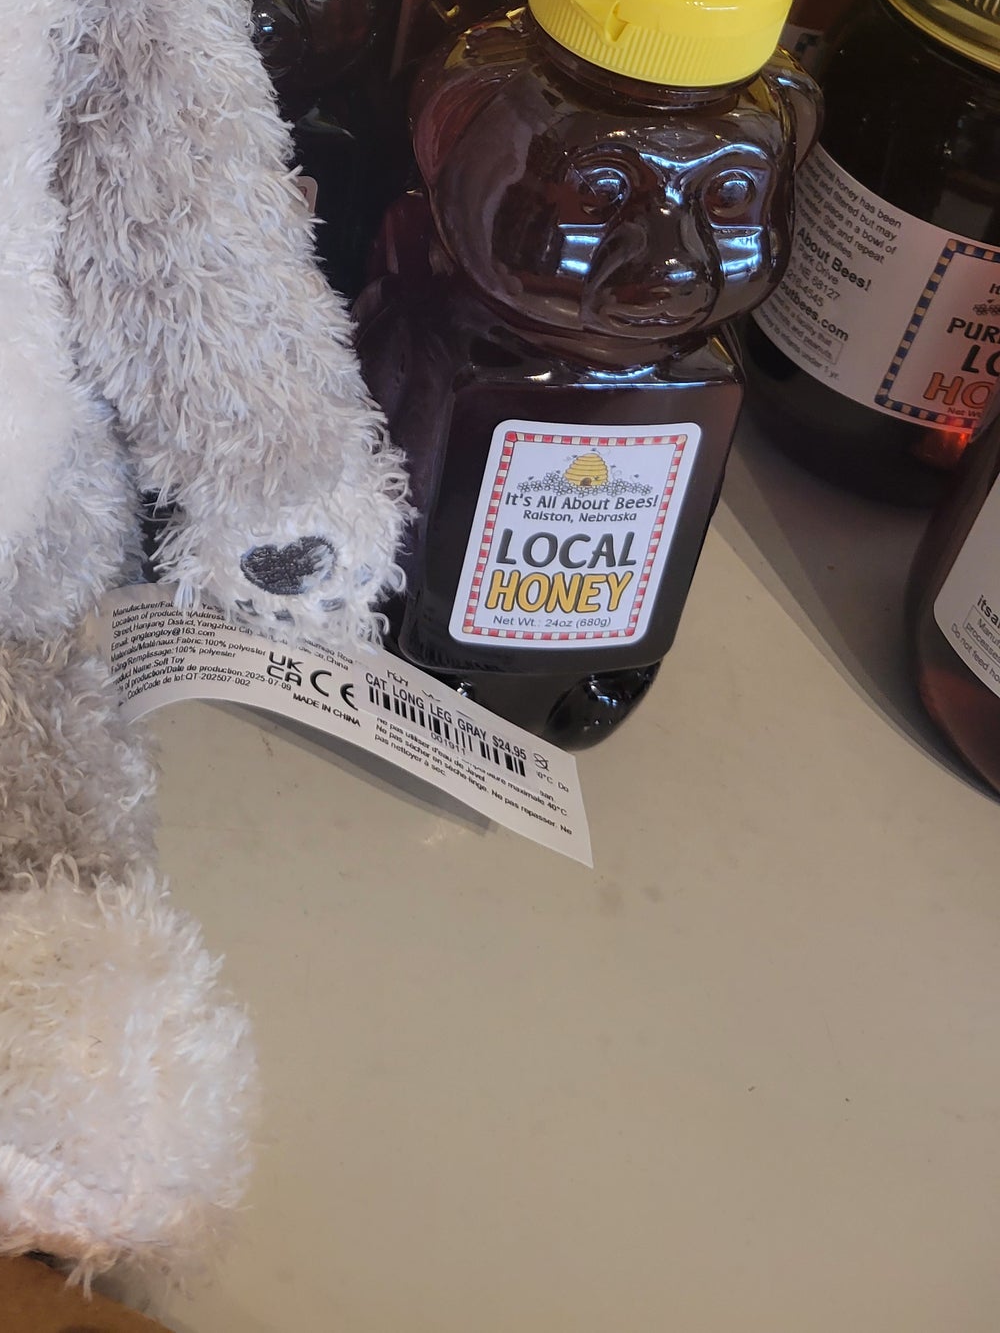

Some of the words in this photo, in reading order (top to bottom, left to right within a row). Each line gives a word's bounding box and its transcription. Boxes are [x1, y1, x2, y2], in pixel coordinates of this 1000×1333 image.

[860, 196, 875, 214] has
[877, 208, 902, 229] been
[859, 213, 875, 228] but
[875, 225, 898, 242] may
[854, 240, 885, 264] repeat
[861, 229, 885, 248] bowl
[884, 245, 897, 256] of
[797, 226, 831, 265] About
[831, 257, 873, 293] Bees!
[815, 262, 840, 285] Drive
[811, 275, 841, 302] 68127
[946, 317, 1000, 345] PUR
[505, 491, 533, 508] It's
[536, 495, 557, 509] All
[561, 496, 610, 510] About
[614, 494, 659, 510] Bees!
[523, 509, 574, 524] Ralston,
[578, 512, 638, 523] Nebraska
[495, 528, 637, 569] LOCAL
[485, 569, 635, 613] HONEY
[493, 615, 515, 626] Net
[545, 617, 573, 628] 24oz
[575, 616, 612, 629] (680g)
[170, 655, 185, 667] Toy
[198, 647, 236, 659] polyester
[228, 643, 267, 657] polyester
[268, 650, 304, 674] UK
[960, 637, 973, 654] not
[972, 649, 991, 671] feed
[186, 664, 198, 672] de
[266, 664, 303, 687] CA
[292, 692, 320, 709] MADE
[322, 703, 332, 714] IN
[332, 708, 362, 728] CHINA
[365, 672, 388, 691] CAT
[392, 684, 425, 710] LONG
[429, 702, 453, 725] LEG
[457, 718, 488, 741] GRAY
[491, 735, 528, 761] $24.95
[374, 733, 390, 746] pas
[389, 723, 404, 735] pas
[430, 732, 467, 757] 001911
[388, 732, 403, 744] pas
[491, 789, 503, 801] Ne
[504, 797, 520, 810] pas
[560, 824, 573, 836] Ne
